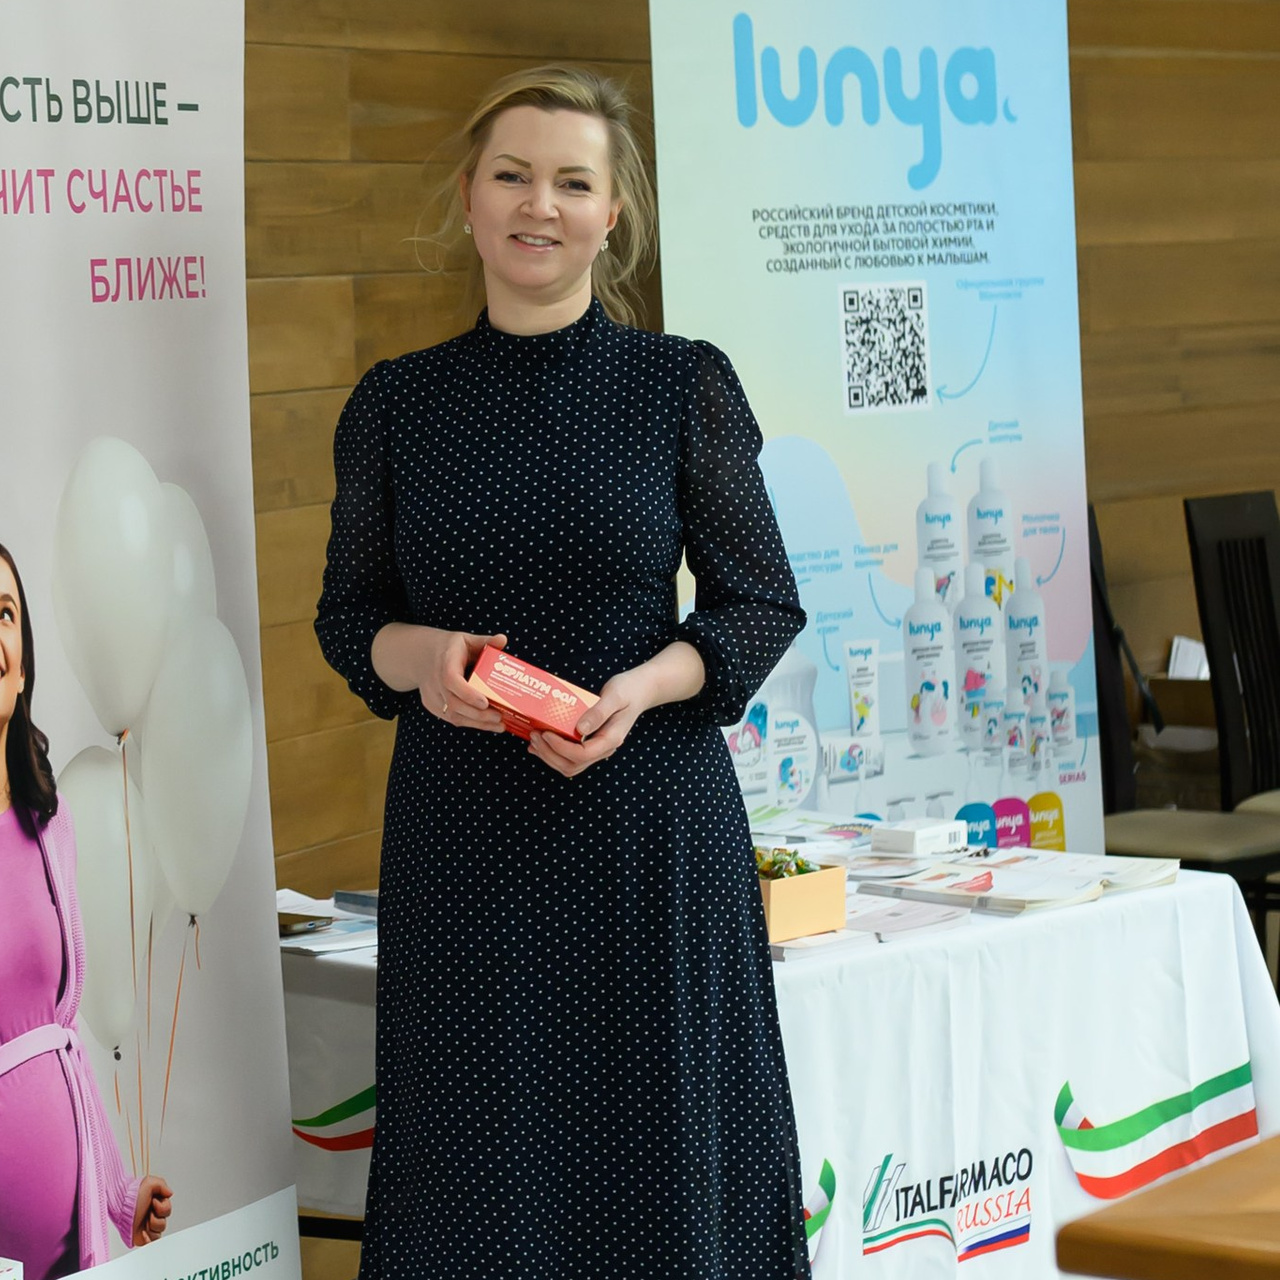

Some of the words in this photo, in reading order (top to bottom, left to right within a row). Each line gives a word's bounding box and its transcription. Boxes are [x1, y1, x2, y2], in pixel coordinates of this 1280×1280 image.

[72, 78, 169, 126] ВЫШЕ
[66, 168, 204, 215] СЧАСТЬЕ
[752, 205, 834, 222] РОССИЙСКИЙ
[837, 205, 875, 221] БРЕНД
[876, 202, 928, 219] ДЕТСКОЙ
[930, 202, 998, 218] КОСМЕТИКИ,
[759, 223, 810, 239] СРЕДСТВ
[813, 223, 837, 239] ДЛЯ
[840, 222, 879, 238] УХОДА
[882, 222, 896, 235] ЗА
[899, 220, 964, 235] ПОЛОСТЬЮ
[966, 220, 984, 233] РТА
[986, 220, 995, 232] И
[783, 238, 870, 255] ЭКОЛОГИЧНОЙ
[873, 235, 929, 251] БЫТОВОЙ
[766, 256, 841, 273] СОЗДАННЫЙ
[844, 256, 851, 268] С
[854, 254, 915, 268] ЛЮБОВЬЮ
[917, 253, 925, 266] К
[89, 256, 207, 303] БЛИЖЕ!
[909, 621, 942, 641] lunya
[959, 616, 992, 635] lunya
[1009, 615, 1039, 636] lunya
[996, 813, 1024, 834] unya
[895, 1148, 1033, 1222] ITALFARMACO
[957, 1186, 1031, 1233] RUSSIA
